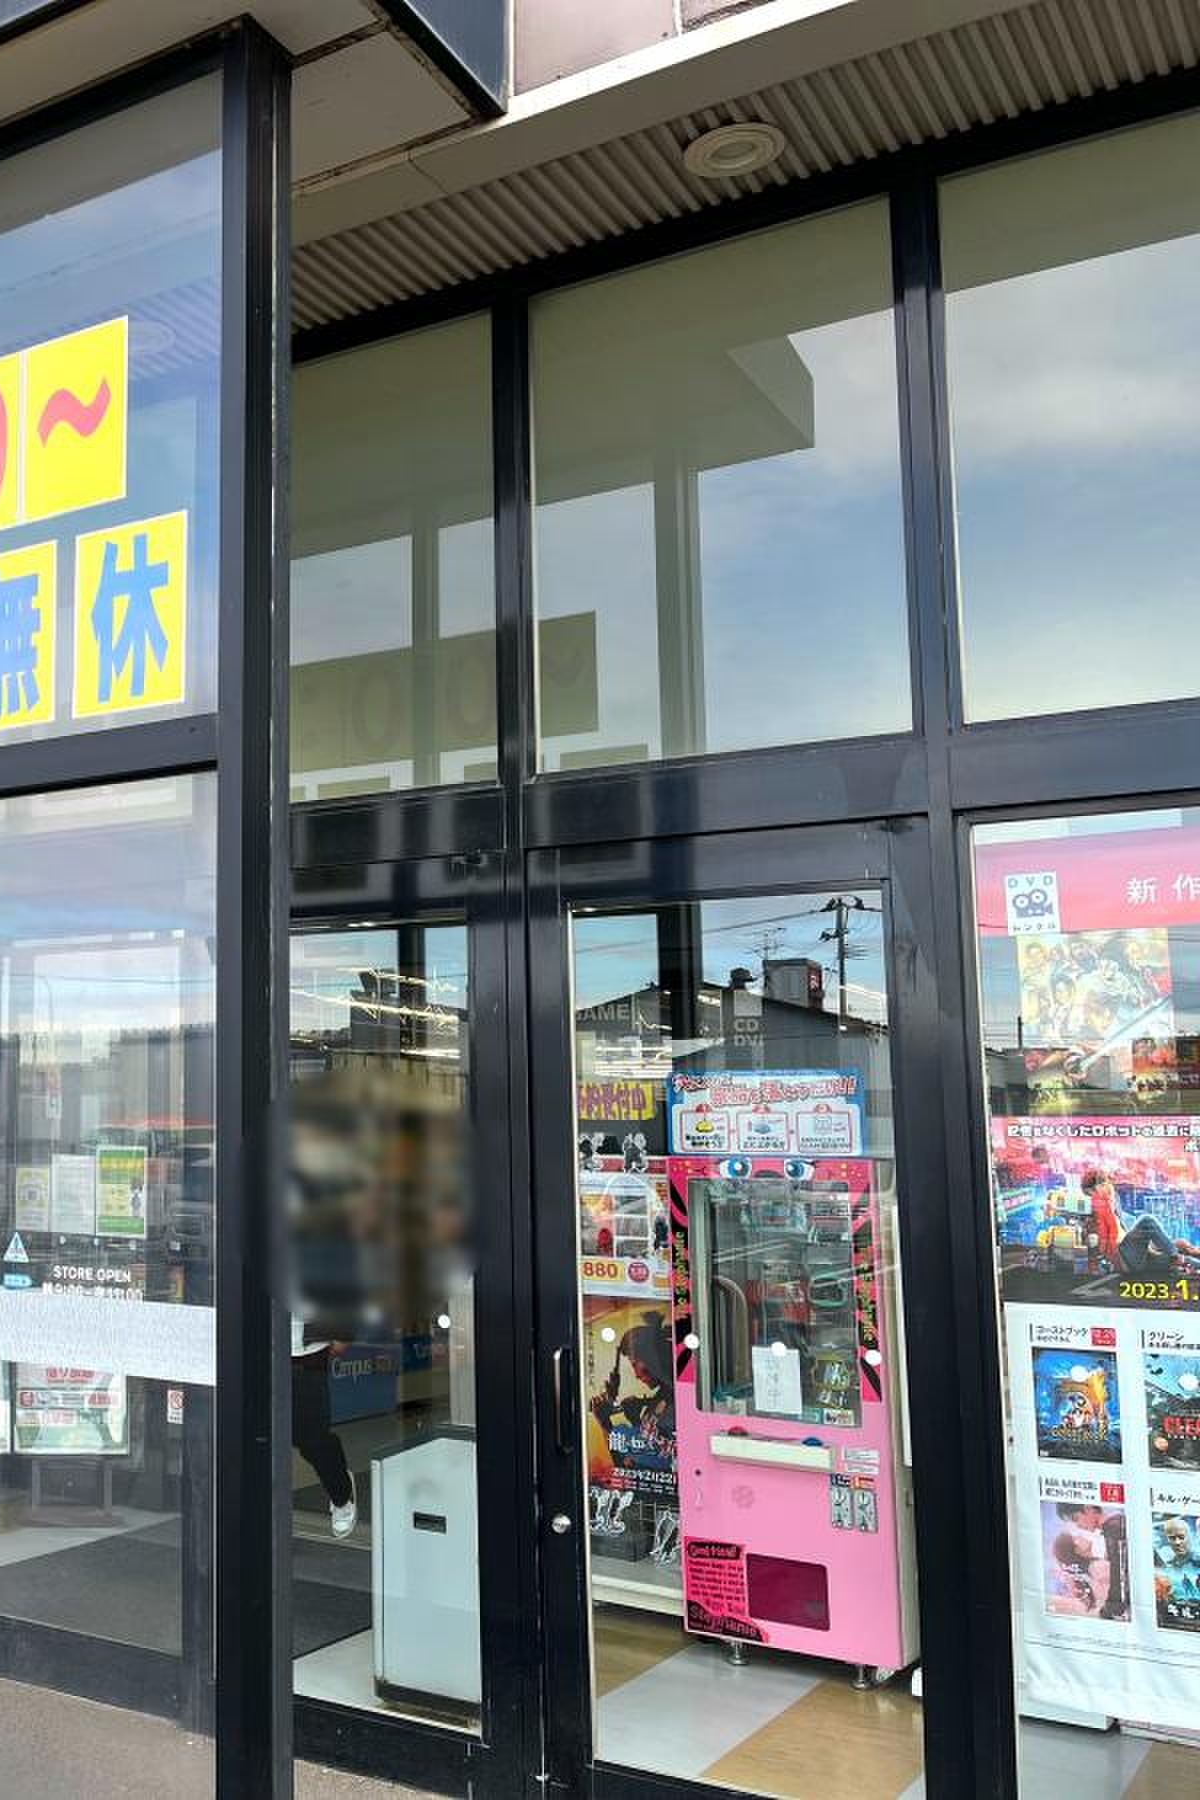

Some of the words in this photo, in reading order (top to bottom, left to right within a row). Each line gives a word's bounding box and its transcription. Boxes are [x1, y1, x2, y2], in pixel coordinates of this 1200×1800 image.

[1008, 874, 1054, 889] DVD
[53, 1264, 94, 1281] STORE
[96, 1268, 131, 1282] OPEN
[582, 1261, 618, 1279] 880
[1149, 1331, 1185, 1342] クリーン
